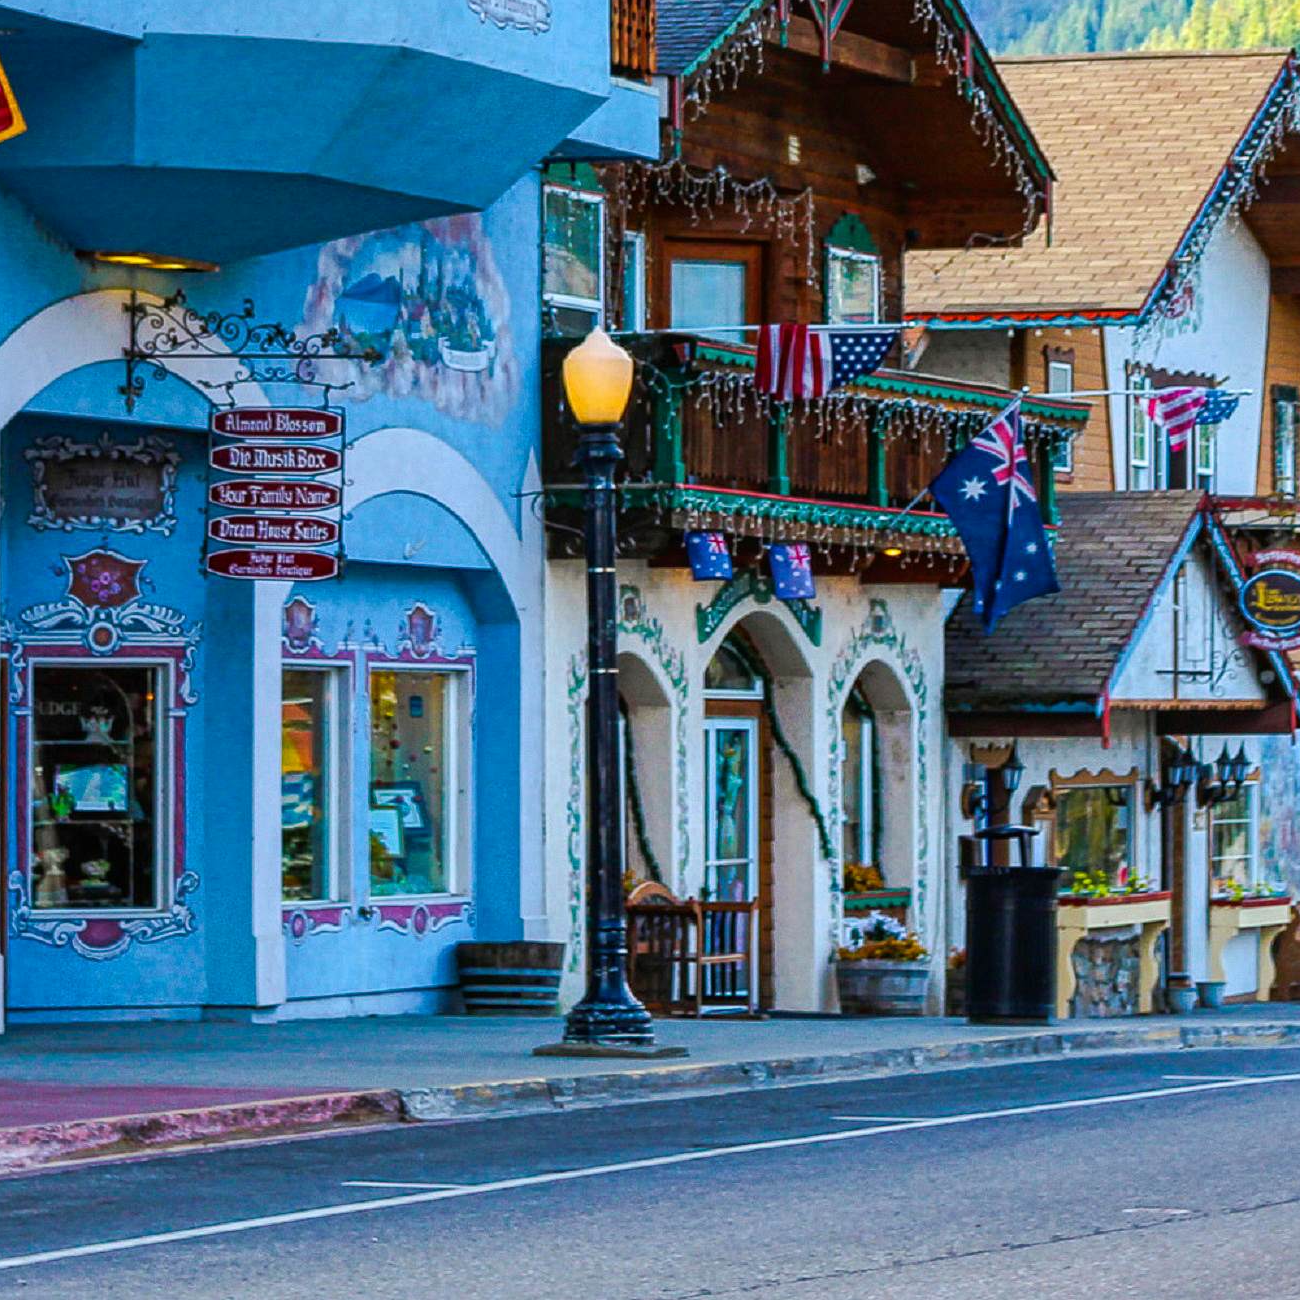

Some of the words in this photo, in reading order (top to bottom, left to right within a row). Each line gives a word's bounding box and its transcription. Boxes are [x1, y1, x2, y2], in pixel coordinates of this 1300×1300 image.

[225, 413, 272, 432] Almond
[276, 413, 327, 433] Blossom
[229, 448, 250, 468] Die
[217, 485, 247, 504] Your
[248, 485, 293, 505] Family
[295, 487, 331, 504] Name
[219, 520, 255, 538] Dream
[257, 520, 292, 539] House
[294, 521, 329, 540] Suites
